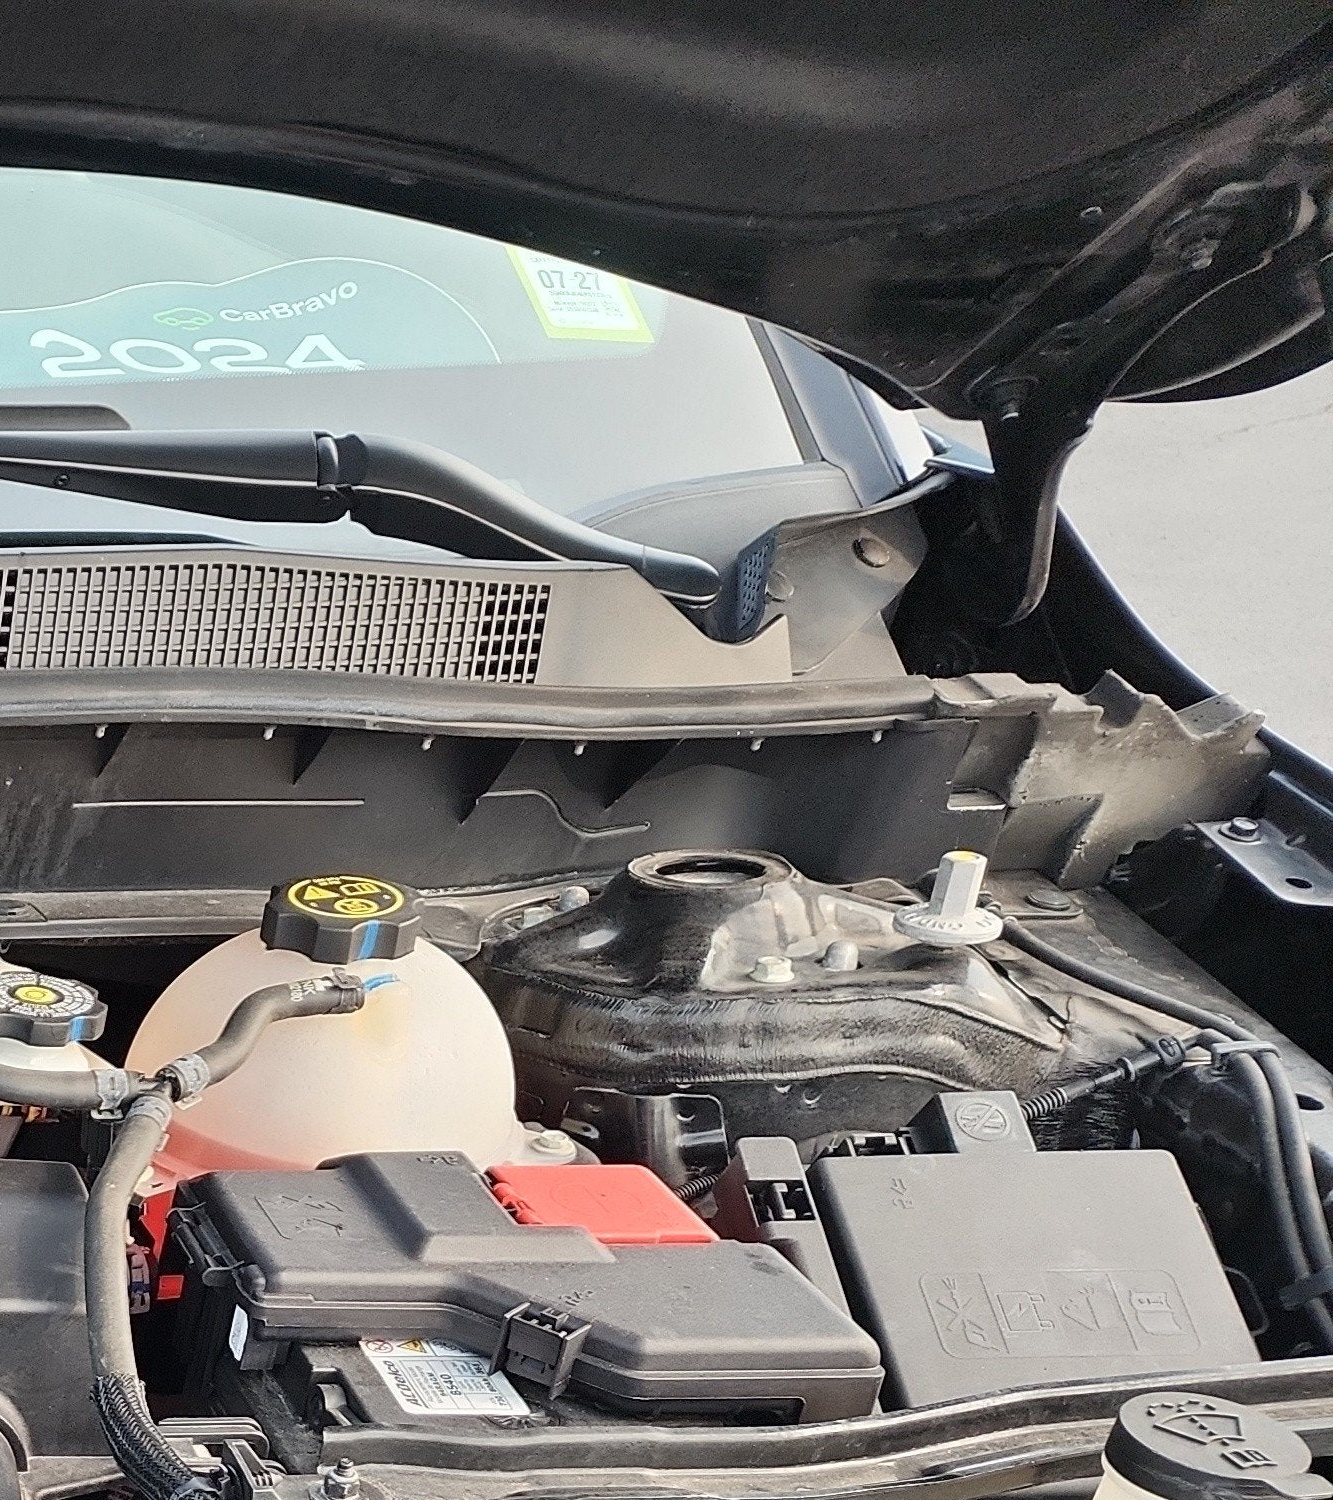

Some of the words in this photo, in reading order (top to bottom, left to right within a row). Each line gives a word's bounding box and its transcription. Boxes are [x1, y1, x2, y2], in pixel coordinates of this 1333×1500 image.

[219, 281, 359, 322] CarBravo
[29, 328, 366, 378] 2024
[382, 1360, 423, 1407] ACDelco
